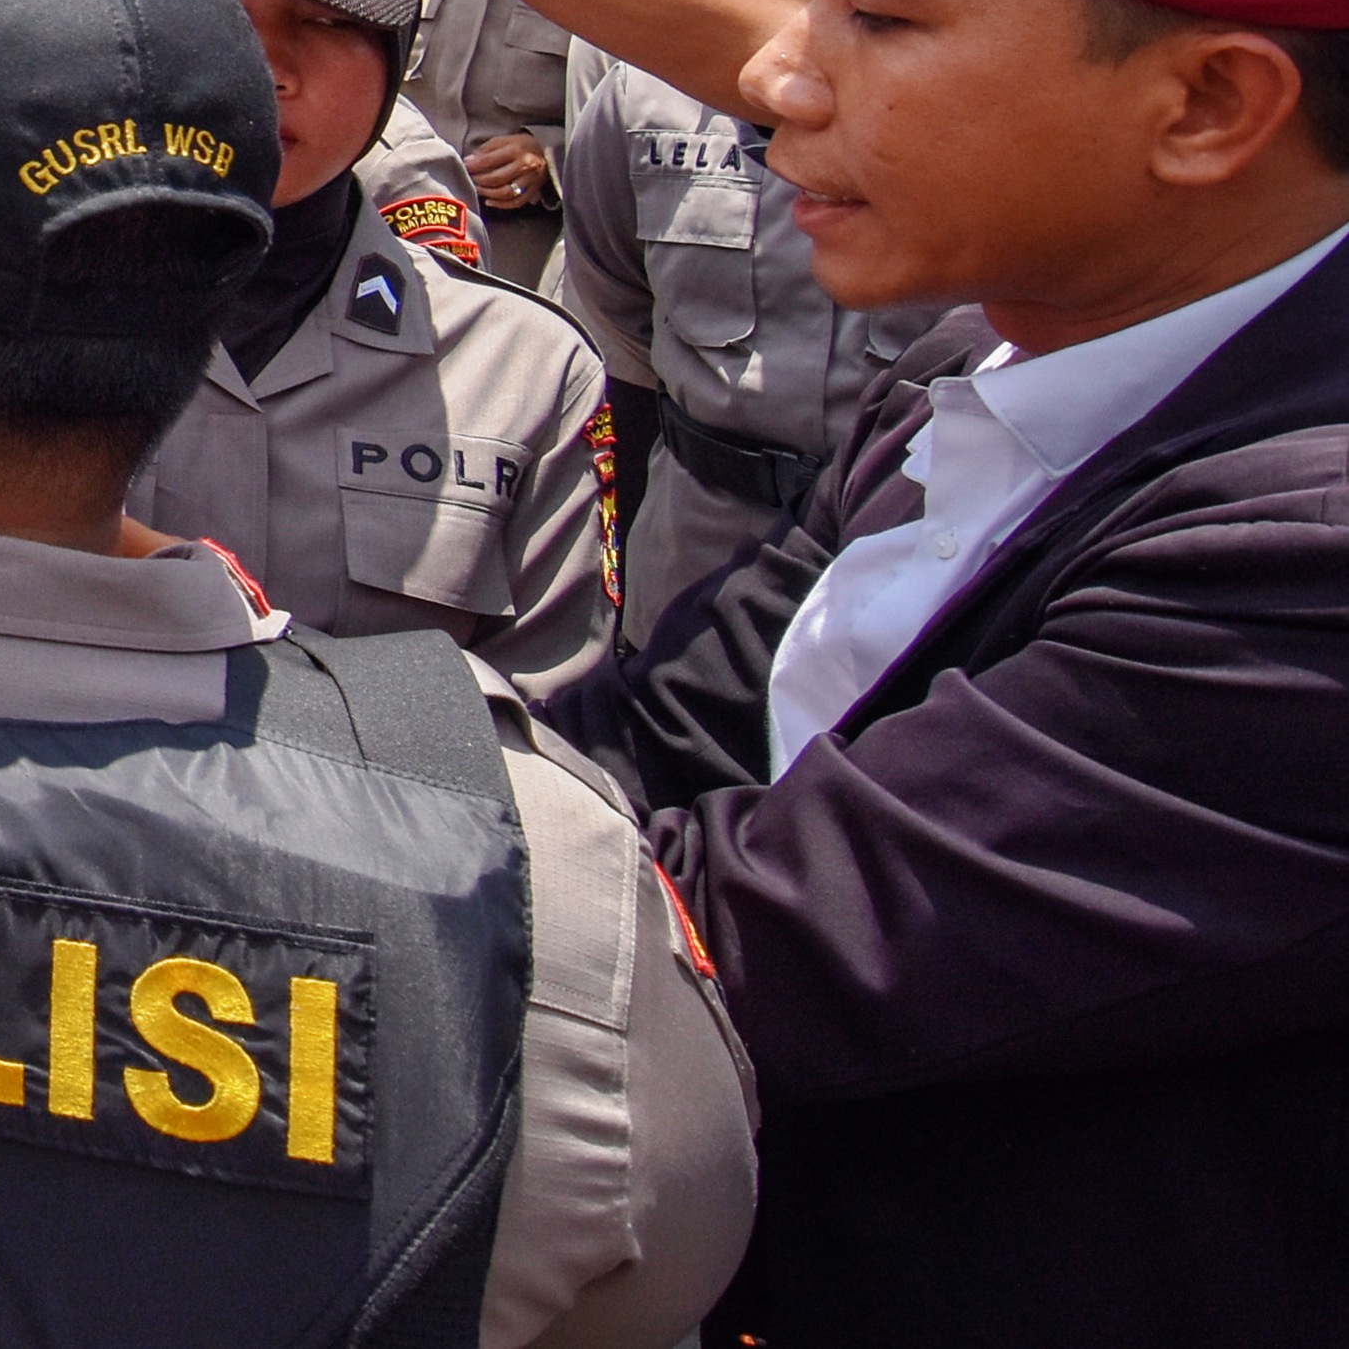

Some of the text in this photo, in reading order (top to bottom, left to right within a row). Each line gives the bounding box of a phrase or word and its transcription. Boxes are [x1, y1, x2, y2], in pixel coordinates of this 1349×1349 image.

[18, 118, 235, 196] GUSRL WSB
[649, 136, 742, 172] LELA
[384, 200, 458, 225] POLRES
[396, 213, 450, 234] MATARAM
[351, 440, 519, 499] POLR
